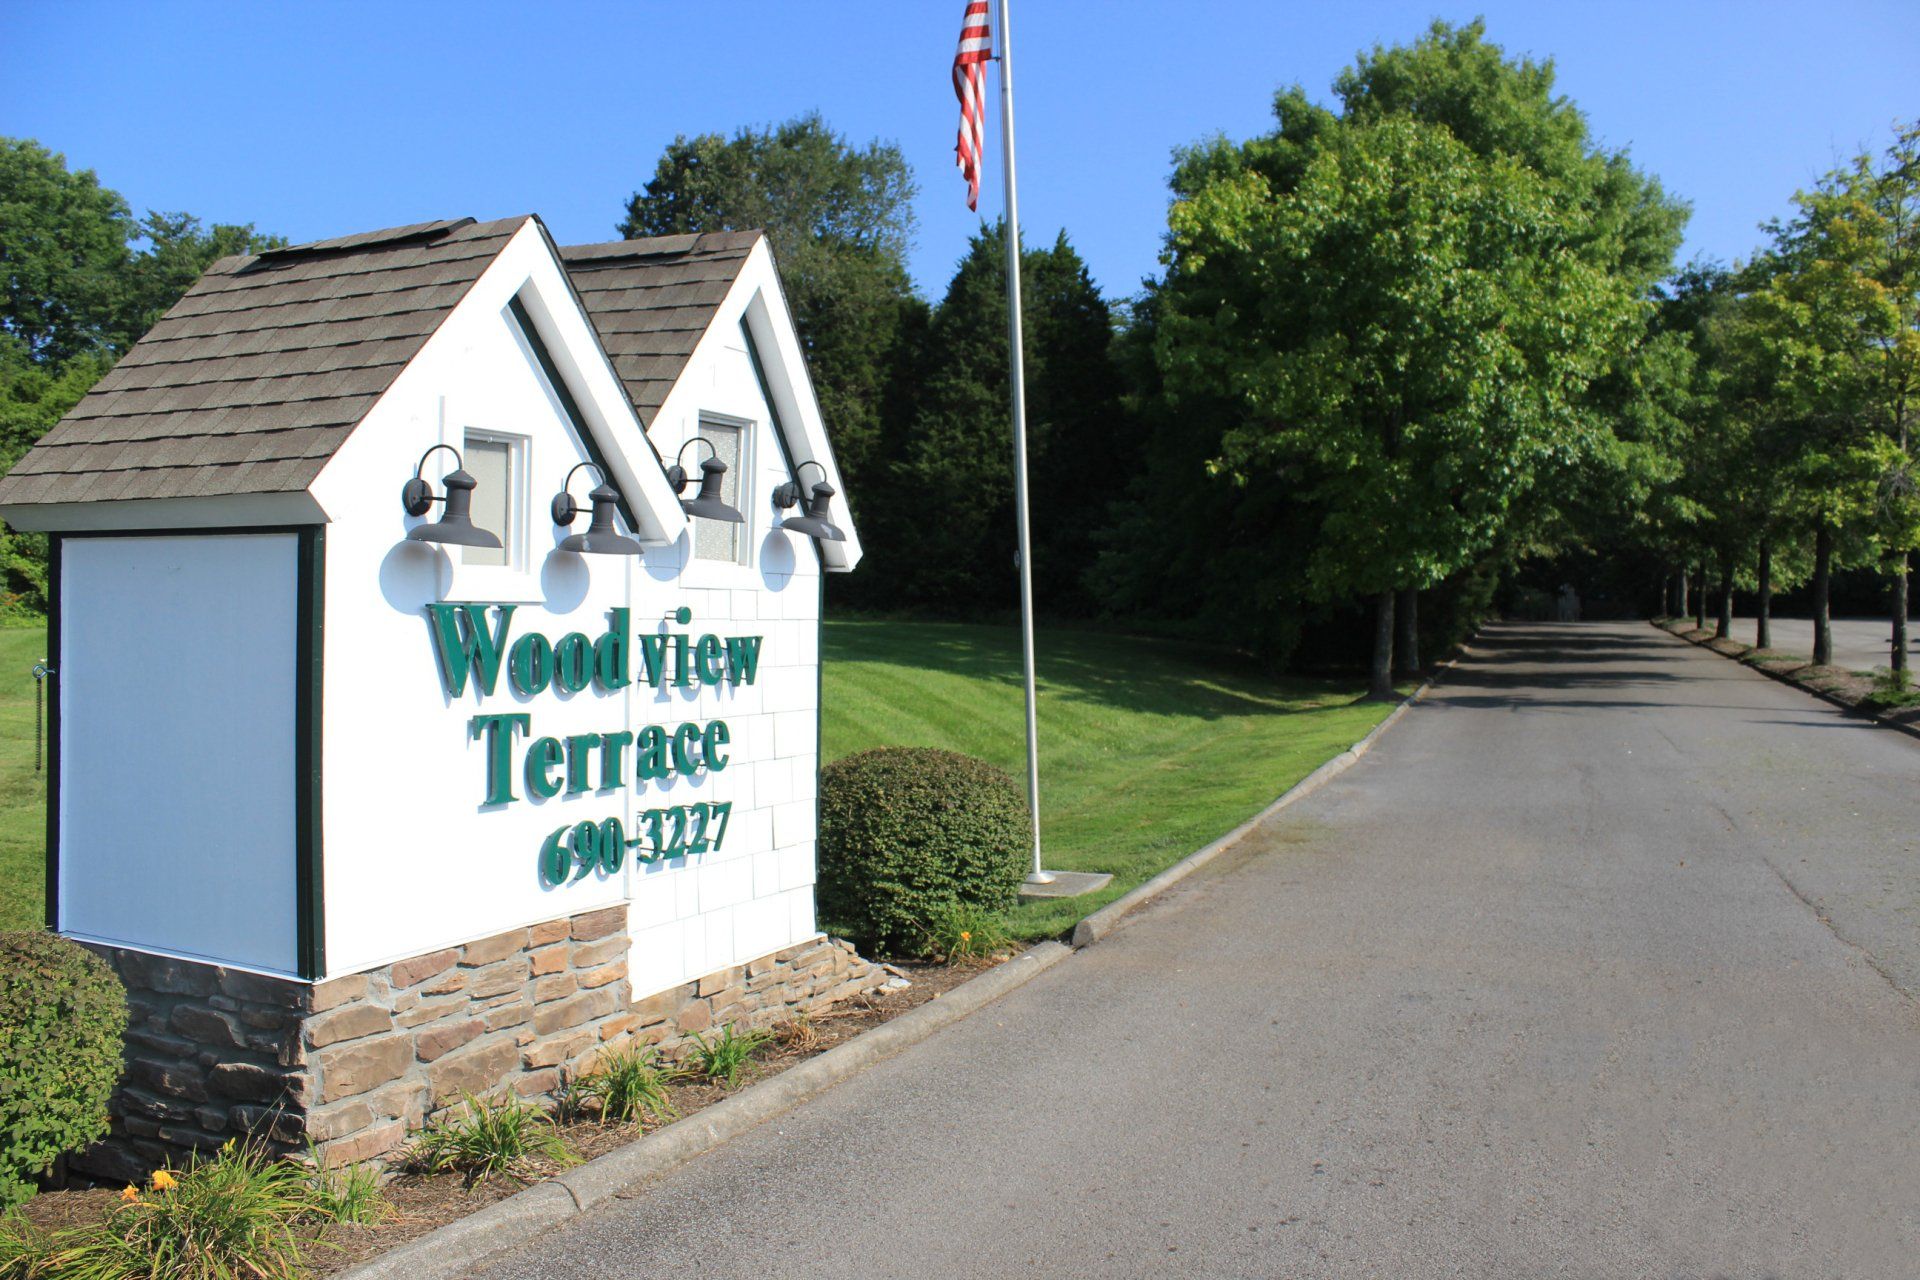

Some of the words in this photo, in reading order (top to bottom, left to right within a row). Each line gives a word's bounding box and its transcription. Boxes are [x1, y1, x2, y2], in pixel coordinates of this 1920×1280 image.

[425, 603, 763, 699] Woodview
[472, 712, 731, 806] Terrace
[540, 801, 733, 885] 690-3227
